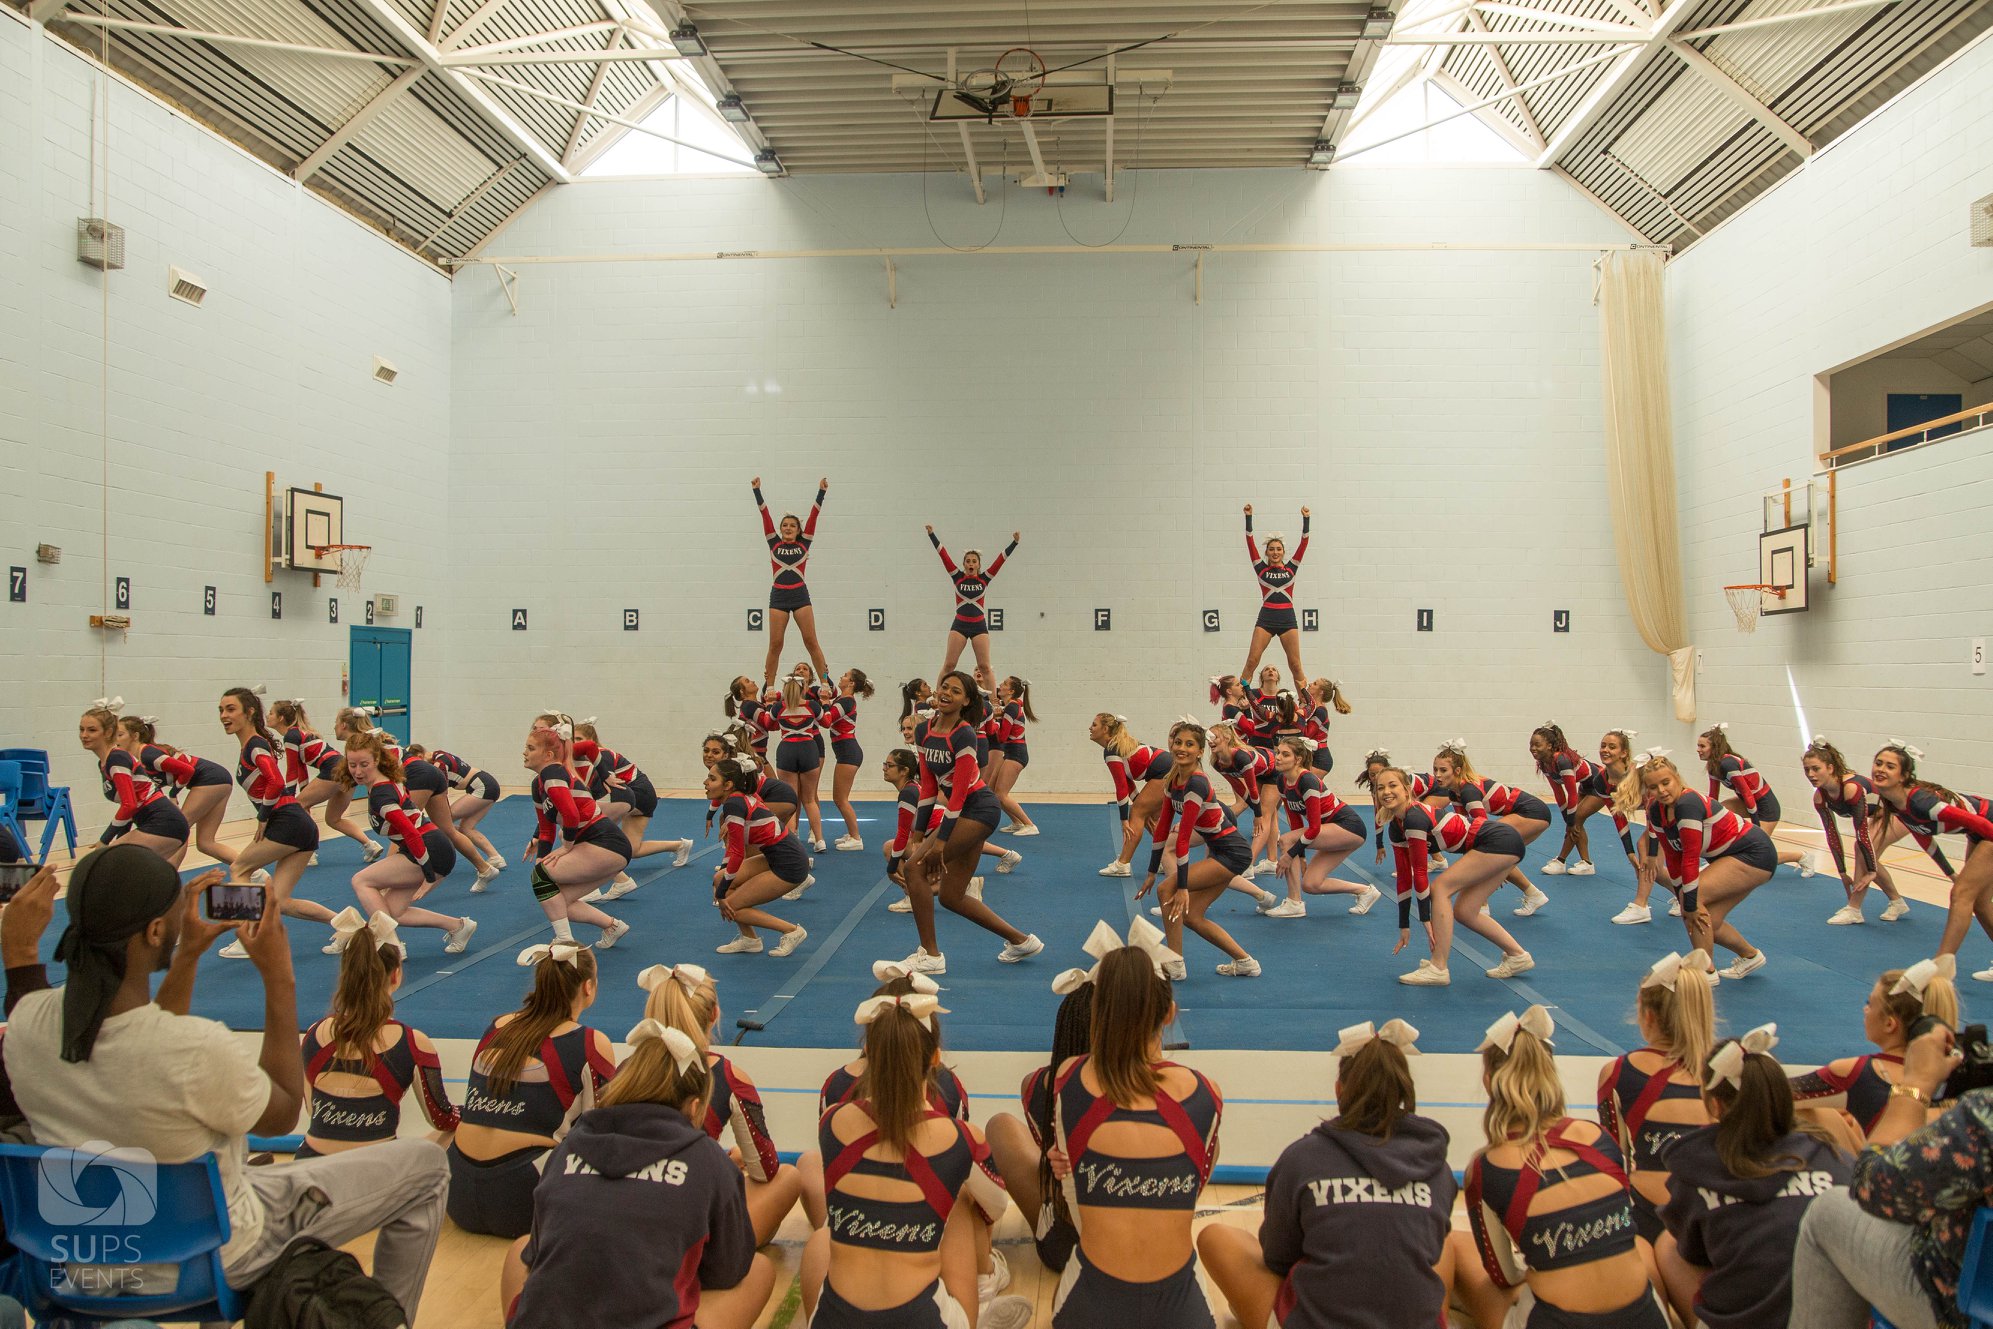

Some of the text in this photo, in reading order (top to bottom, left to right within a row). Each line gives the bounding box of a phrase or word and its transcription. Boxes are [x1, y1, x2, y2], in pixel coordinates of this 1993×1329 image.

[777, 547, 803, 555] VIXENS
[13, 572, 24, 594] 7
[1265, 571, 1291, 579] VIXENS
[118, 582, 128, 602] 6
[960, 583, 984, 592] VIXENS
[206, 590, 214, 608] 5
[273, 595, 280, 613] 4
[330, 601, 337, 618] 3
[366, 603, 373, 620] 2
[416, 608, 421, 623] 1
[513, 612, 526, 626] A
[626, 612, 638, 626] B
[749, 611, 762, 626] C
[870, 612, 883, 626] D
[990, 611, 1002, 626] E
[1097, 611, 1109, 626] F
[1205, 612, 1219, 627] G
[1304, 611, 1317, 627] H
[1556, 612, 1566, 627] J
[1975, 646, 1982, 664] 5
[925, 748, 952, 764] IXENS
[312, 1098, 387, 1128] Vixens
[563, 1153, 688, 1186] VNS
[1079, 1162, 1196, 1197] Vixens
[1307, 1177, 1432, 1209] VIXENS
[1697, 1171, 1833, 1211] VNS
[829, 1205, 936, 1242] Vixens
[1532, 1206, 1631, 1258] Vixens
